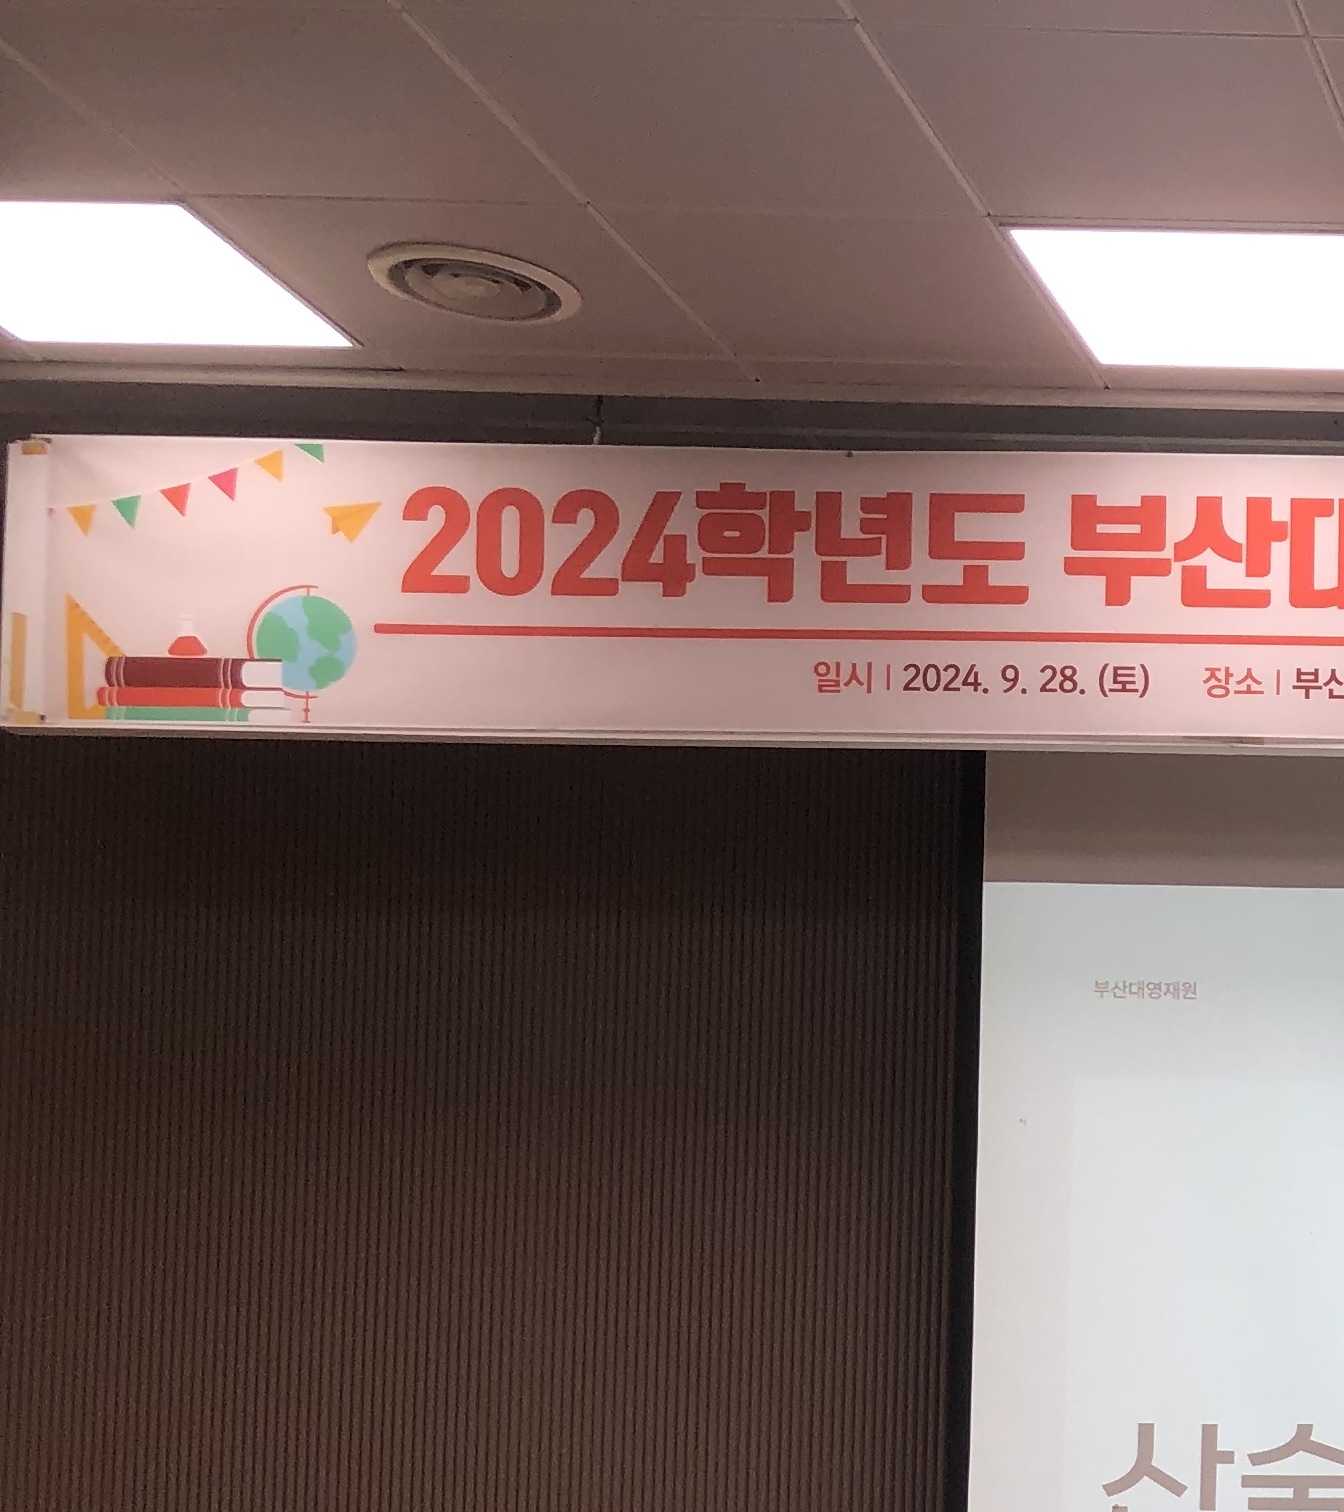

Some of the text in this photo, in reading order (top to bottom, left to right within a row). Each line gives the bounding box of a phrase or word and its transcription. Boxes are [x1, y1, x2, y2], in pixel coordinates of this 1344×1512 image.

[400, 482, 1029, 605] 2024학년도
[813, 660, 873, 694] 일시
[902, 663, 990, 695] 2024.
[1000, 664, 1028, 695] 9.
[1039, 664, 1086, 696] 28.
[1098, 662, 1150, 699] (토)
[1202, 666, 1265, 699] 장소
[1093, 979, 1197, 1000] 부산대영재원
